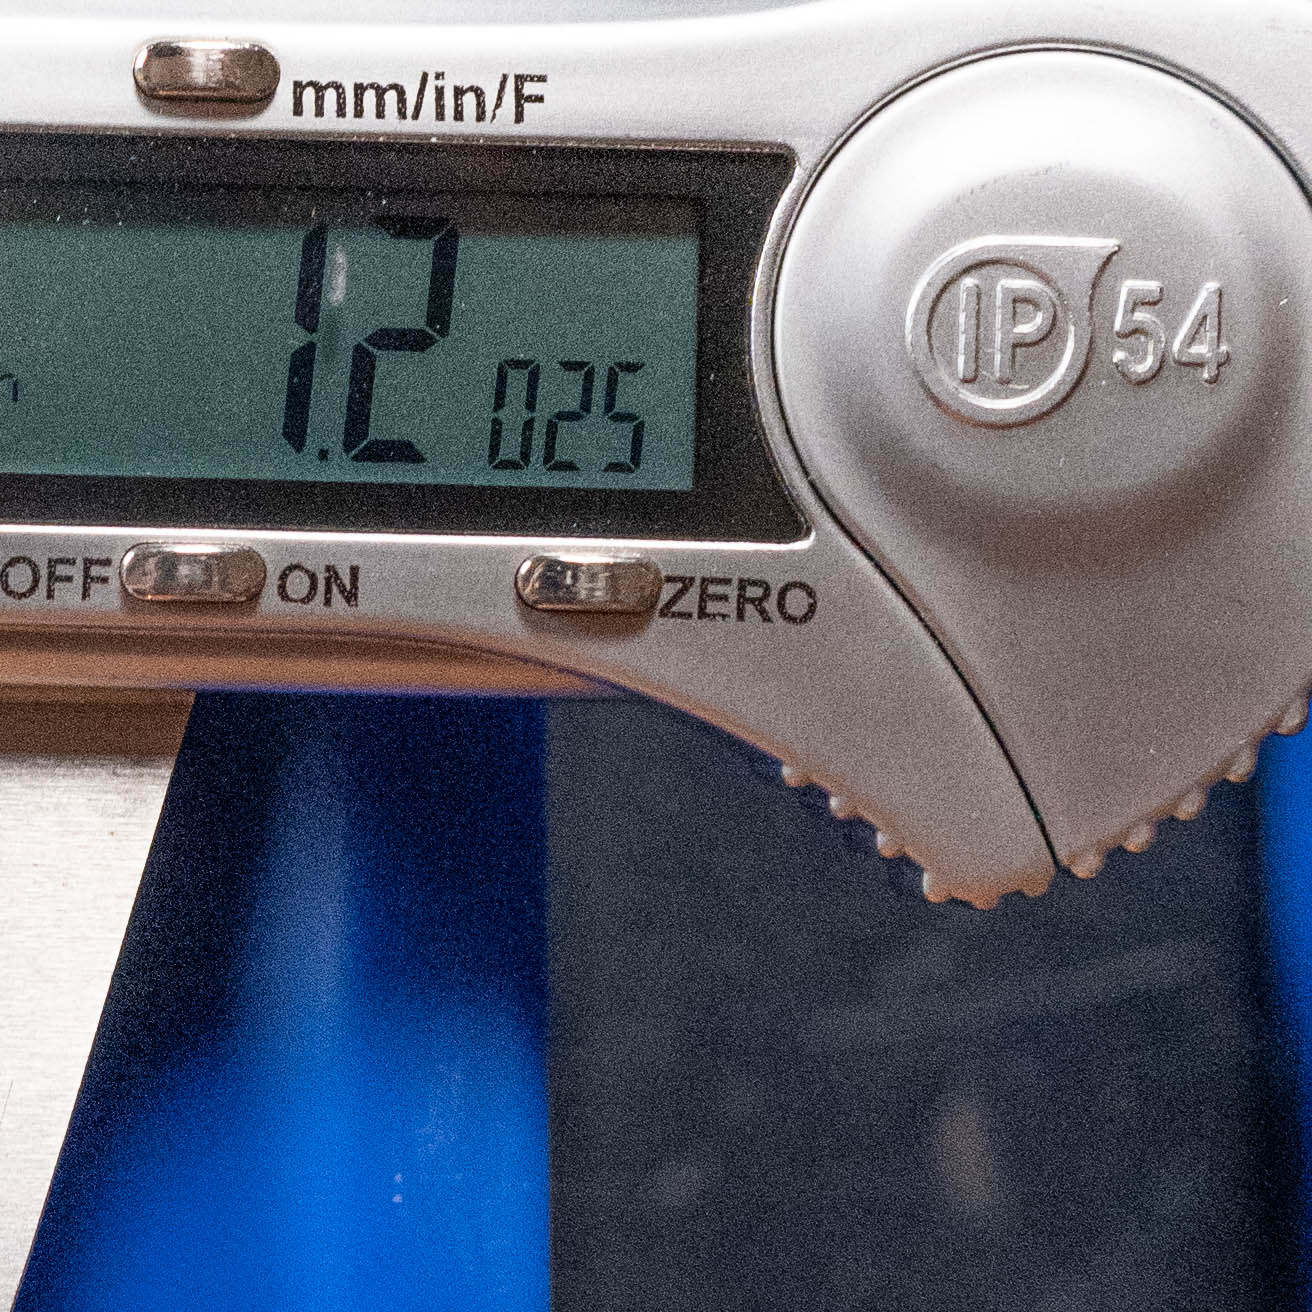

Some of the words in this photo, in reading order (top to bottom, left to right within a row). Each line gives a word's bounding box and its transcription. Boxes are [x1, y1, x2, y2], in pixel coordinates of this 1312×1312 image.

[290, 71, 549, 125] mm/in/F
[956, 277, 1058, 386] IP
[1110, 279, 1231, 387] 54
[276, 563, 361, 609] ON
[658, 573, 819, 625] ZERO
